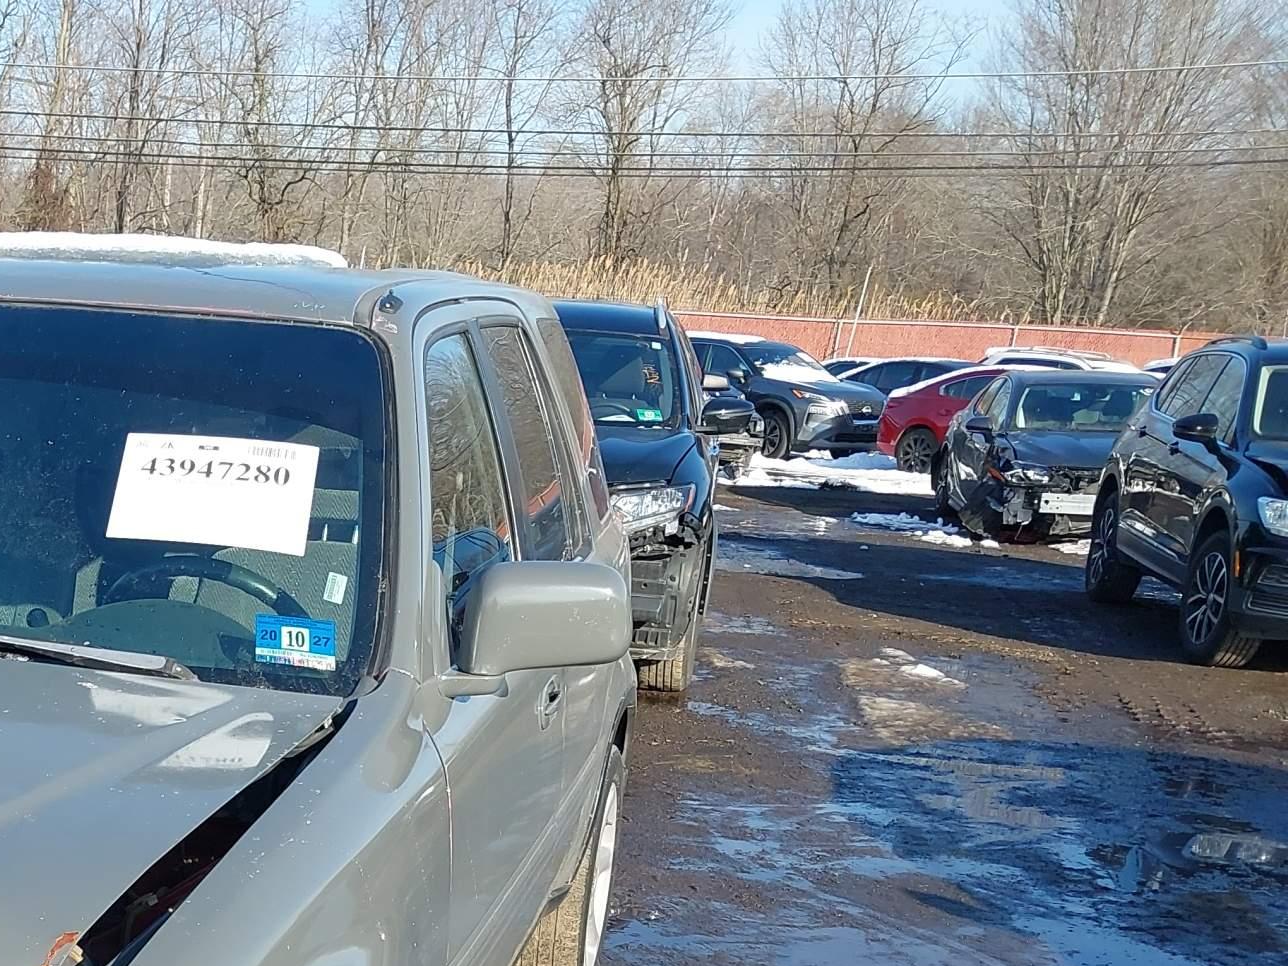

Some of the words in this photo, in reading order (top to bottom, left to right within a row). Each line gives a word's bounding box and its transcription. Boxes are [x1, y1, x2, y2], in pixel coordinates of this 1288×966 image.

[140, 456, 291, 487] 43947280
[260, 629, 278, 641] 20
[286, 630, 305, 648] 10
[312, 635, 331, 648] 27
